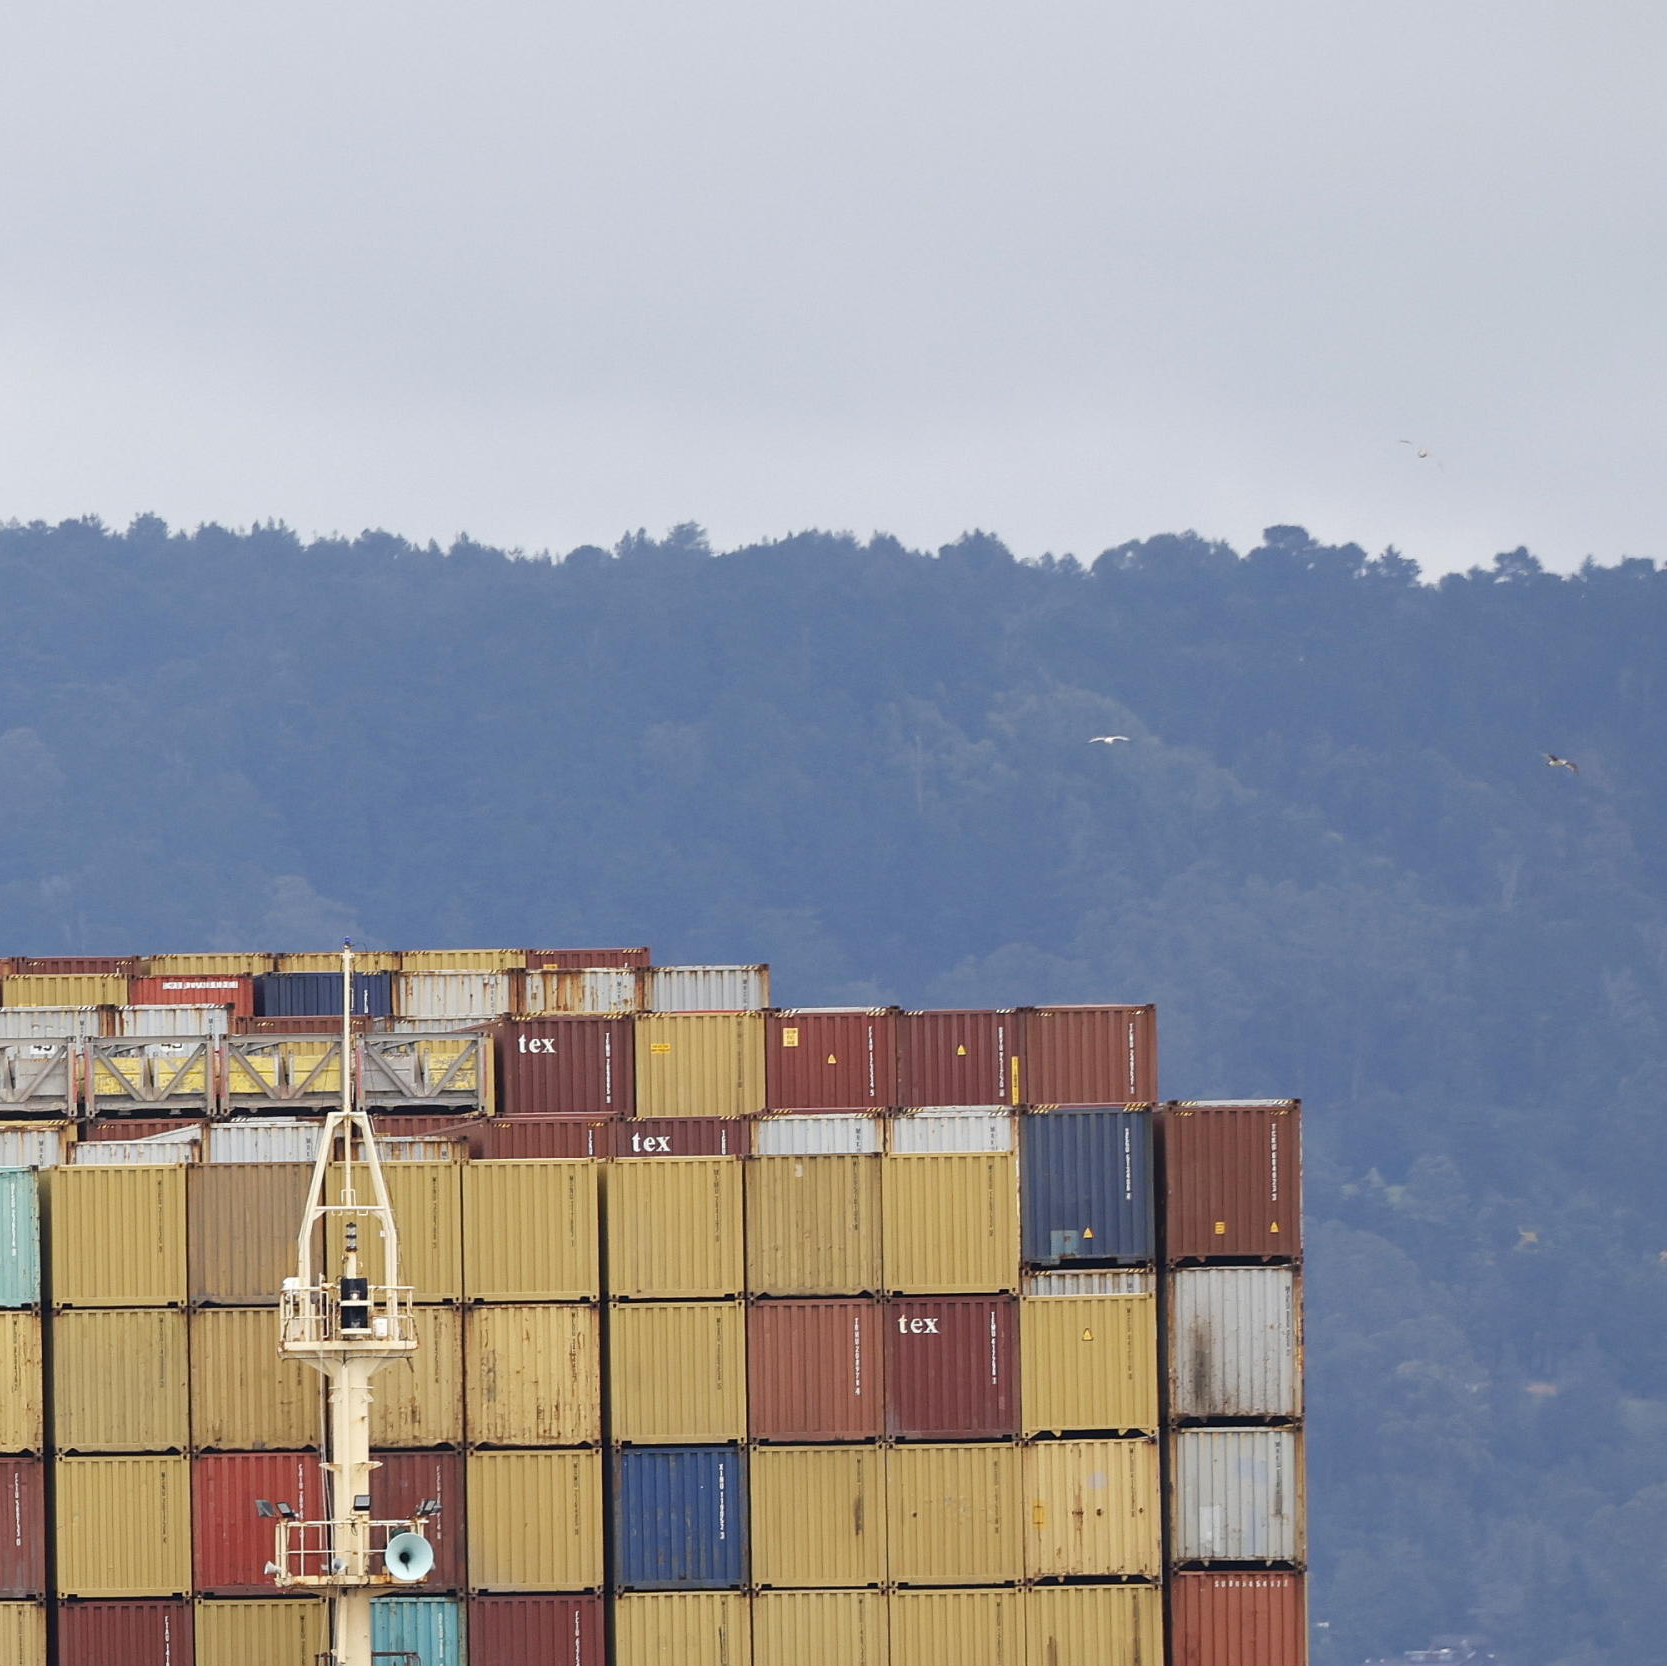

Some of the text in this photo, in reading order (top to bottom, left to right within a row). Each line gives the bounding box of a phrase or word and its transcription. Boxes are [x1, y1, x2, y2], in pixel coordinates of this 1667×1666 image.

[518, 1034, 556, 1053] tex
[632, 1132, 671, 1152] tex
[898, 1314, 939, 1333] tex
